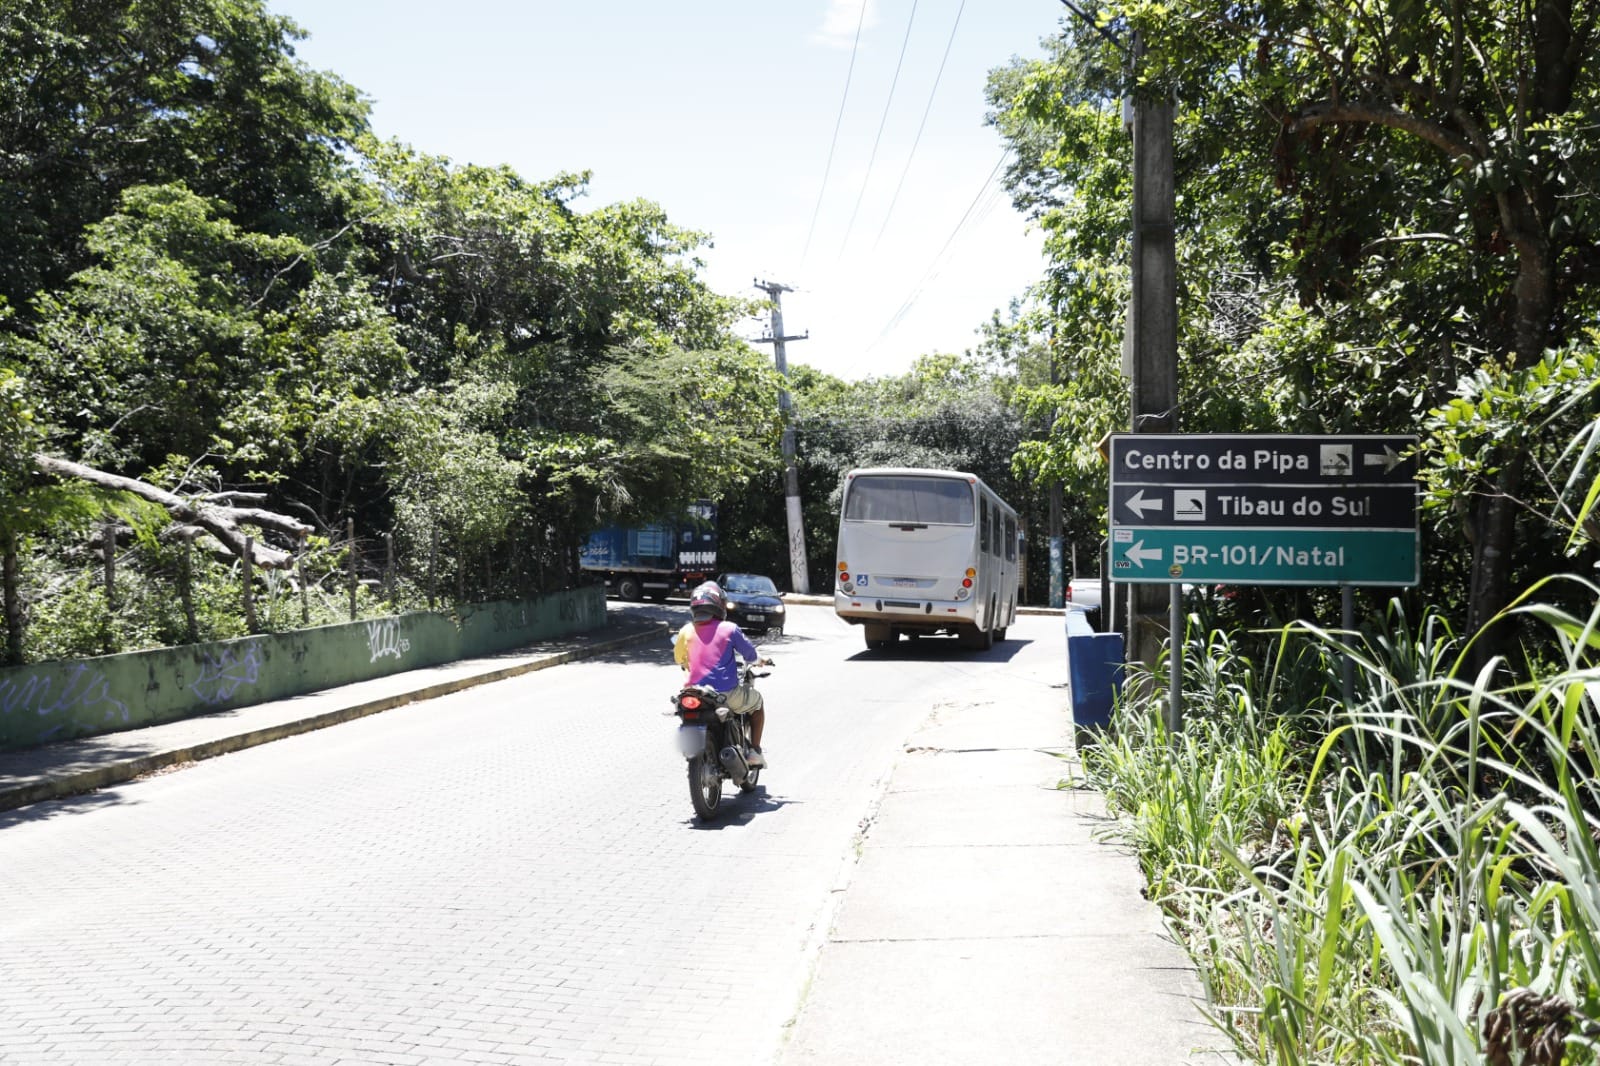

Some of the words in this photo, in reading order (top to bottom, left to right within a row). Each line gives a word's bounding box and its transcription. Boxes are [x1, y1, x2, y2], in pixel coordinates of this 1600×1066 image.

[1124, 449, 1210, 470] Centro
[1217, 449, 1247, 470] da
[1254, 450, 1309, 474] Pipa
[1217, 496, 1285, 516] Tibau
[1292, 496, 1323, 516] do
[1331, 496, 1371, 517] Sul
[1172, 545, 1345, 567] BR-101/Natal
